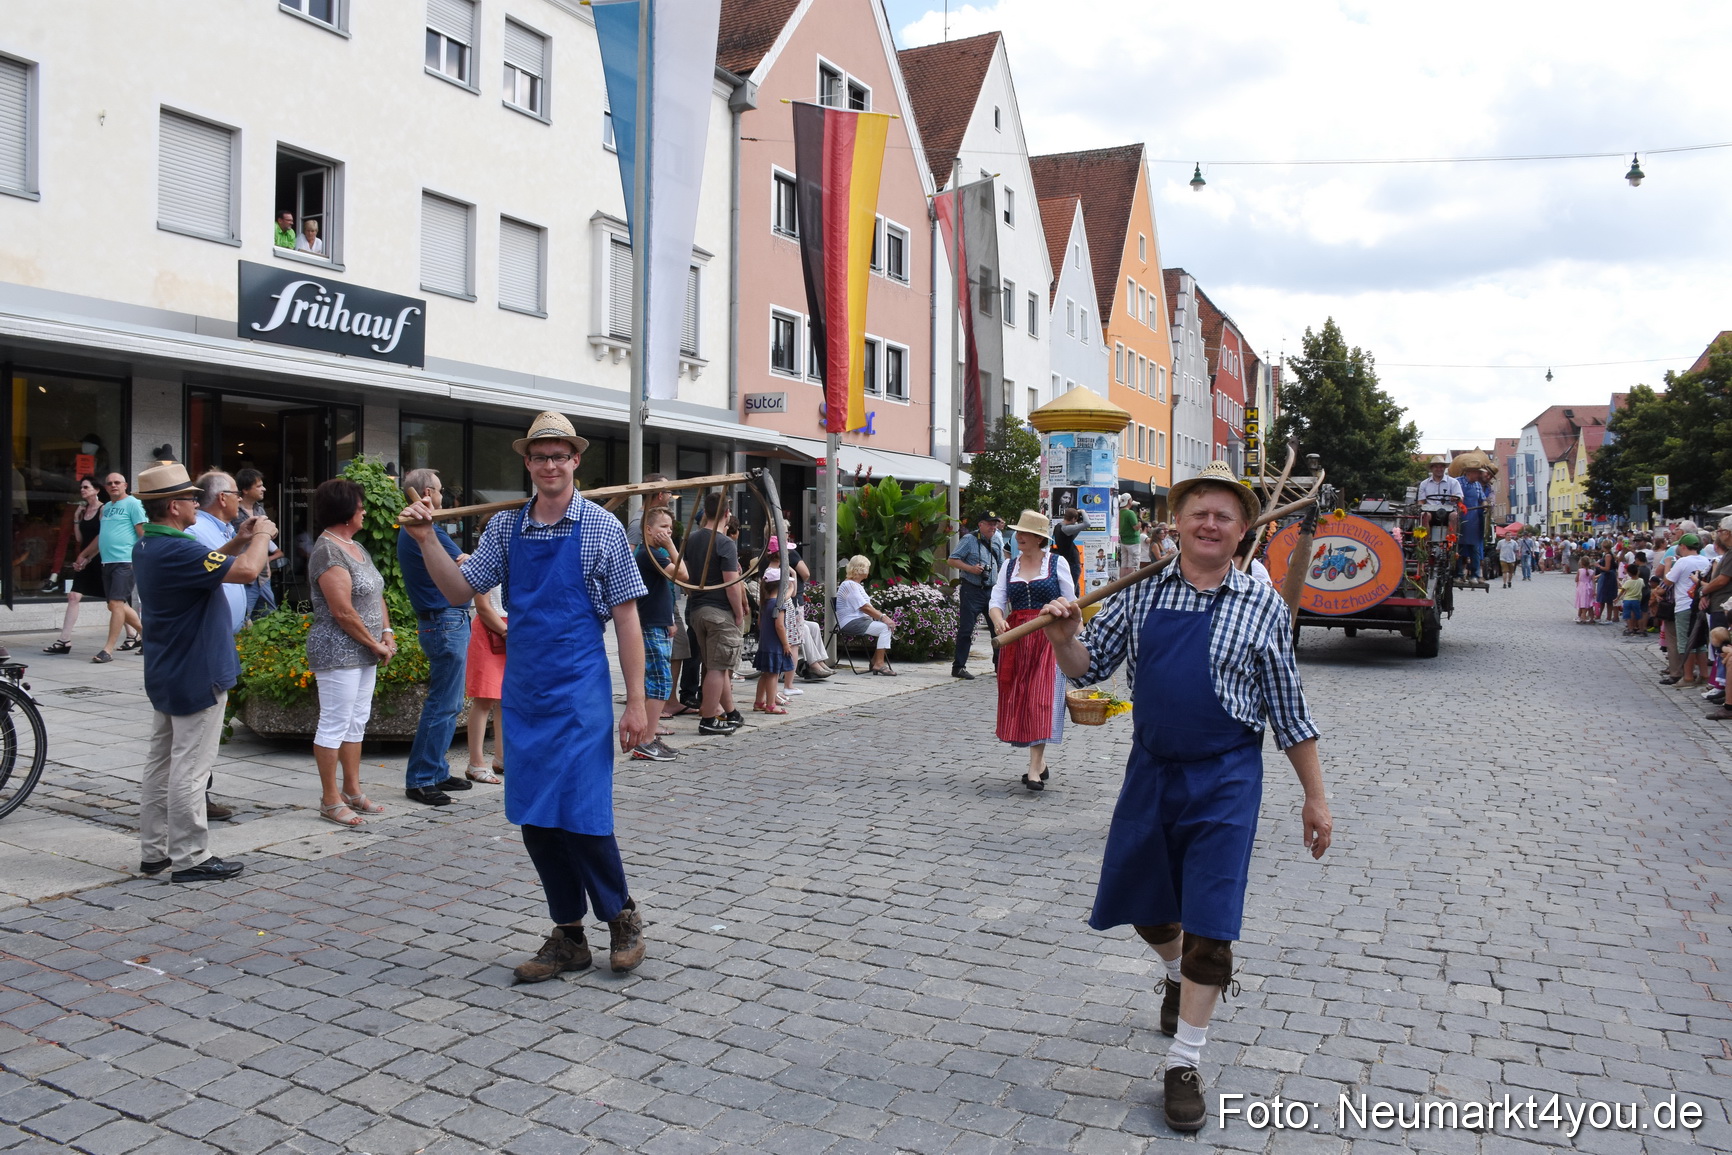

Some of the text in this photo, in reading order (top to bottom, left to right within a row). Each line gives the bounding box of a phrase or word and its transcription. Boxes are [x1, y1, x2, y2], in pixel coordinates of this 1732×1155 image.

[251, 280, 421, 354] frühauf
[1246, 408, 1259, 476] HOTEL
[204, 551, 227, 572] 48
[1311, 583, 1389, 610] Batzhausen
